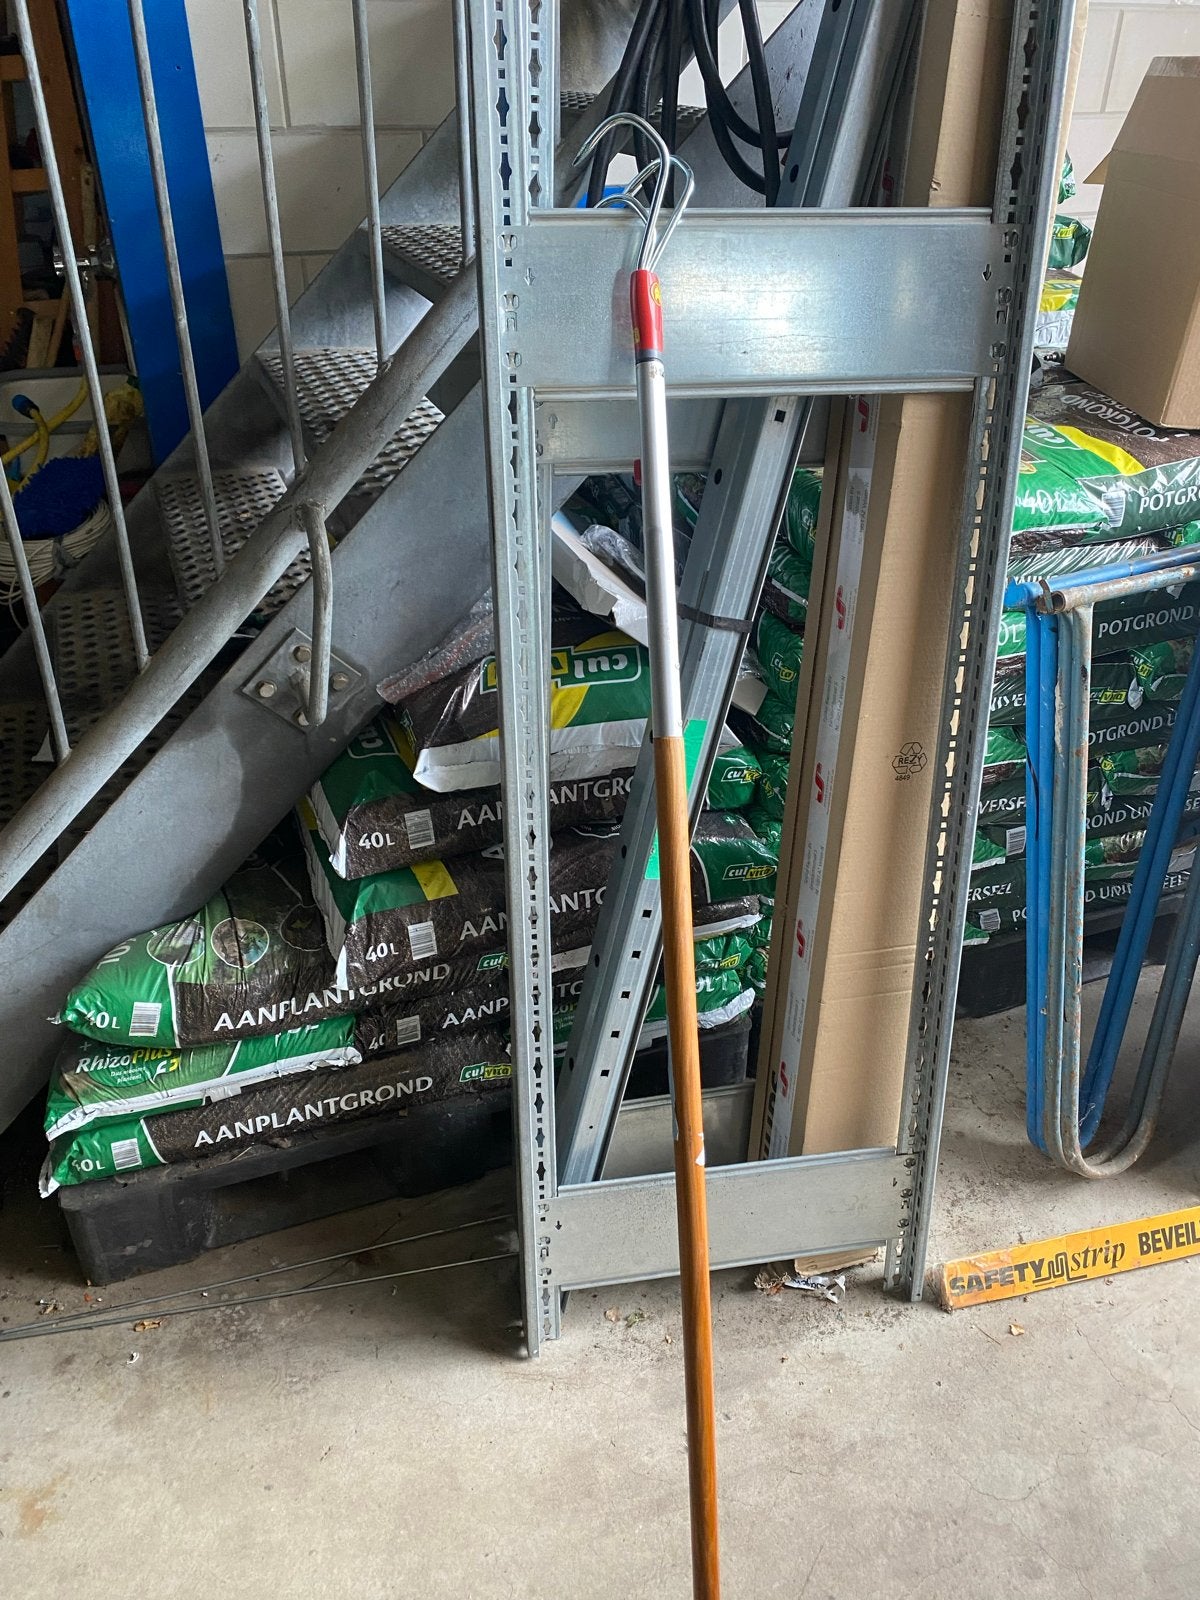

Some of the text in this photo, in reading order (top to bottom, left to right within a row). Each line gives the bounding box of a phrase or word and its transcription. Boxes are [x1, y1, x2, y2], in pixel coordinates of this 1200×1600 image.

[1139, 486, 1200, 514] POTGR
[998, 621, 1020, 646] 0L
[1098, 605, 1193, 638] POTGROND
[1088, 714, 1163, 745] OTGROND
[898, 755, 922, 765] REZY
[193, 1076, 433, 1148] AANPLANTGROND
[950, 1219, 1200, 1297] SAFETY strip BEVEIL
